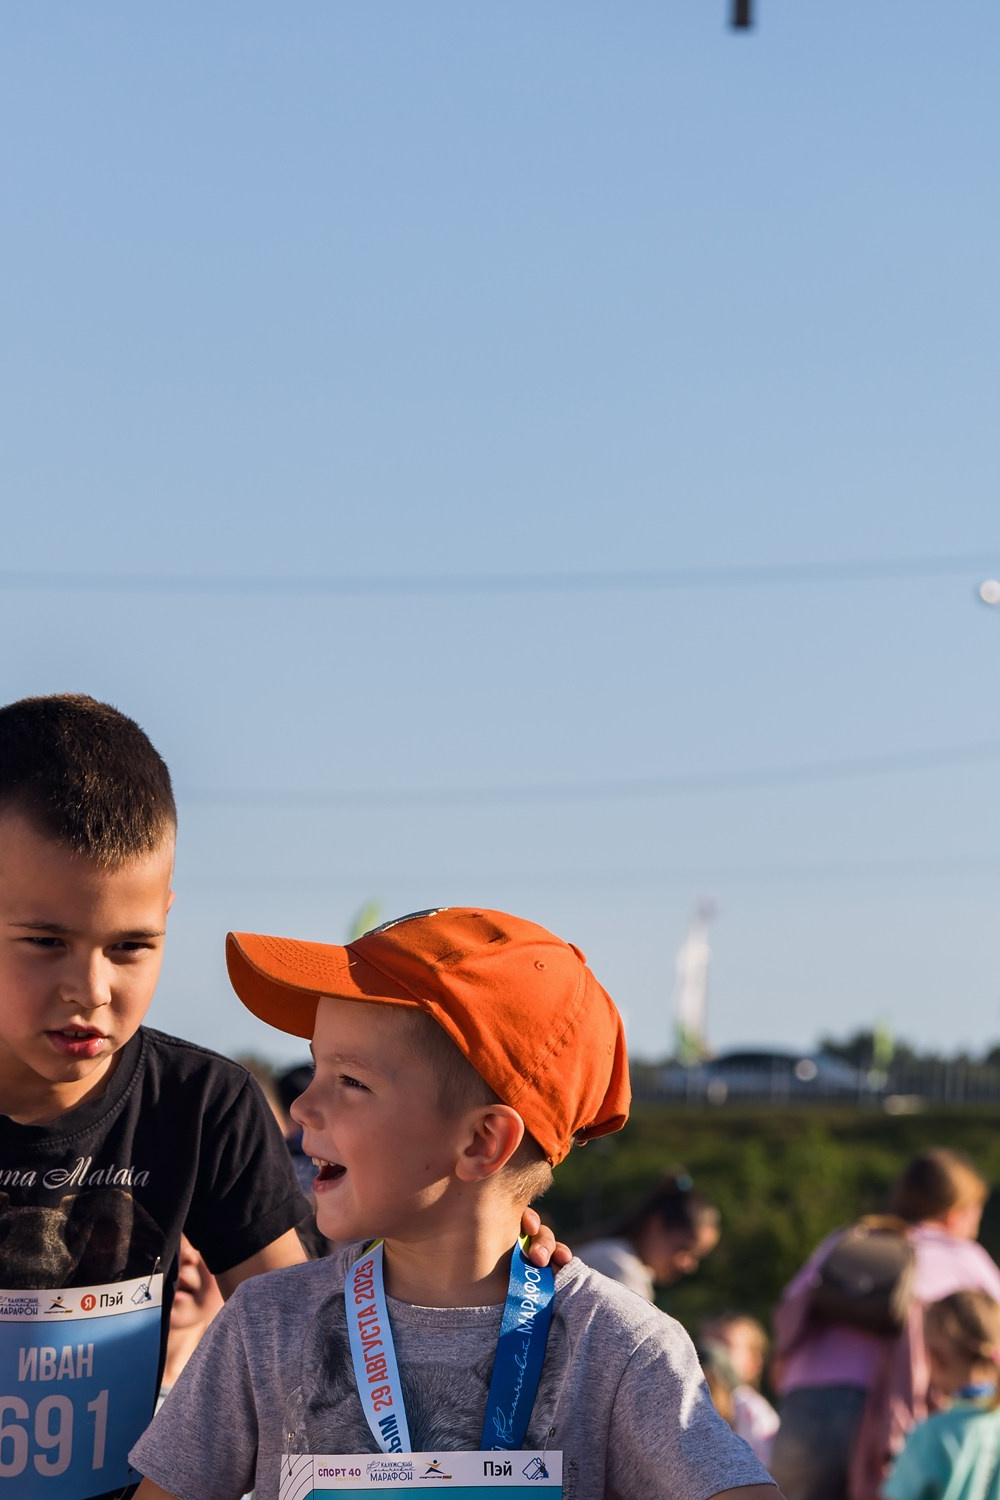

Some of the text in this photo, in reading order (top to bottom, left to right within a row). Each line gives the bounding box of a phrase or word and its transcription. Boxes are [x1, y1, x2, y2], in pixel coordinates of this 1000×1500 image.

[43, 1156, 150, 1190] Matata
[353, 1259, 376, 1305] 2025
[100, 1291, 124, 1308] Пэй
[358, 1304, 389, 1383] АВГУСТА
[18, 1343, 94, 1382] ИВАН
[371, 1385, 393, 1412] 29
[318, 1467, 361, 1478] СПОРТ 40
[370, 1472, 413, 1481] МАРАФОН
[483, 1460, 513, 1477] Пэй
